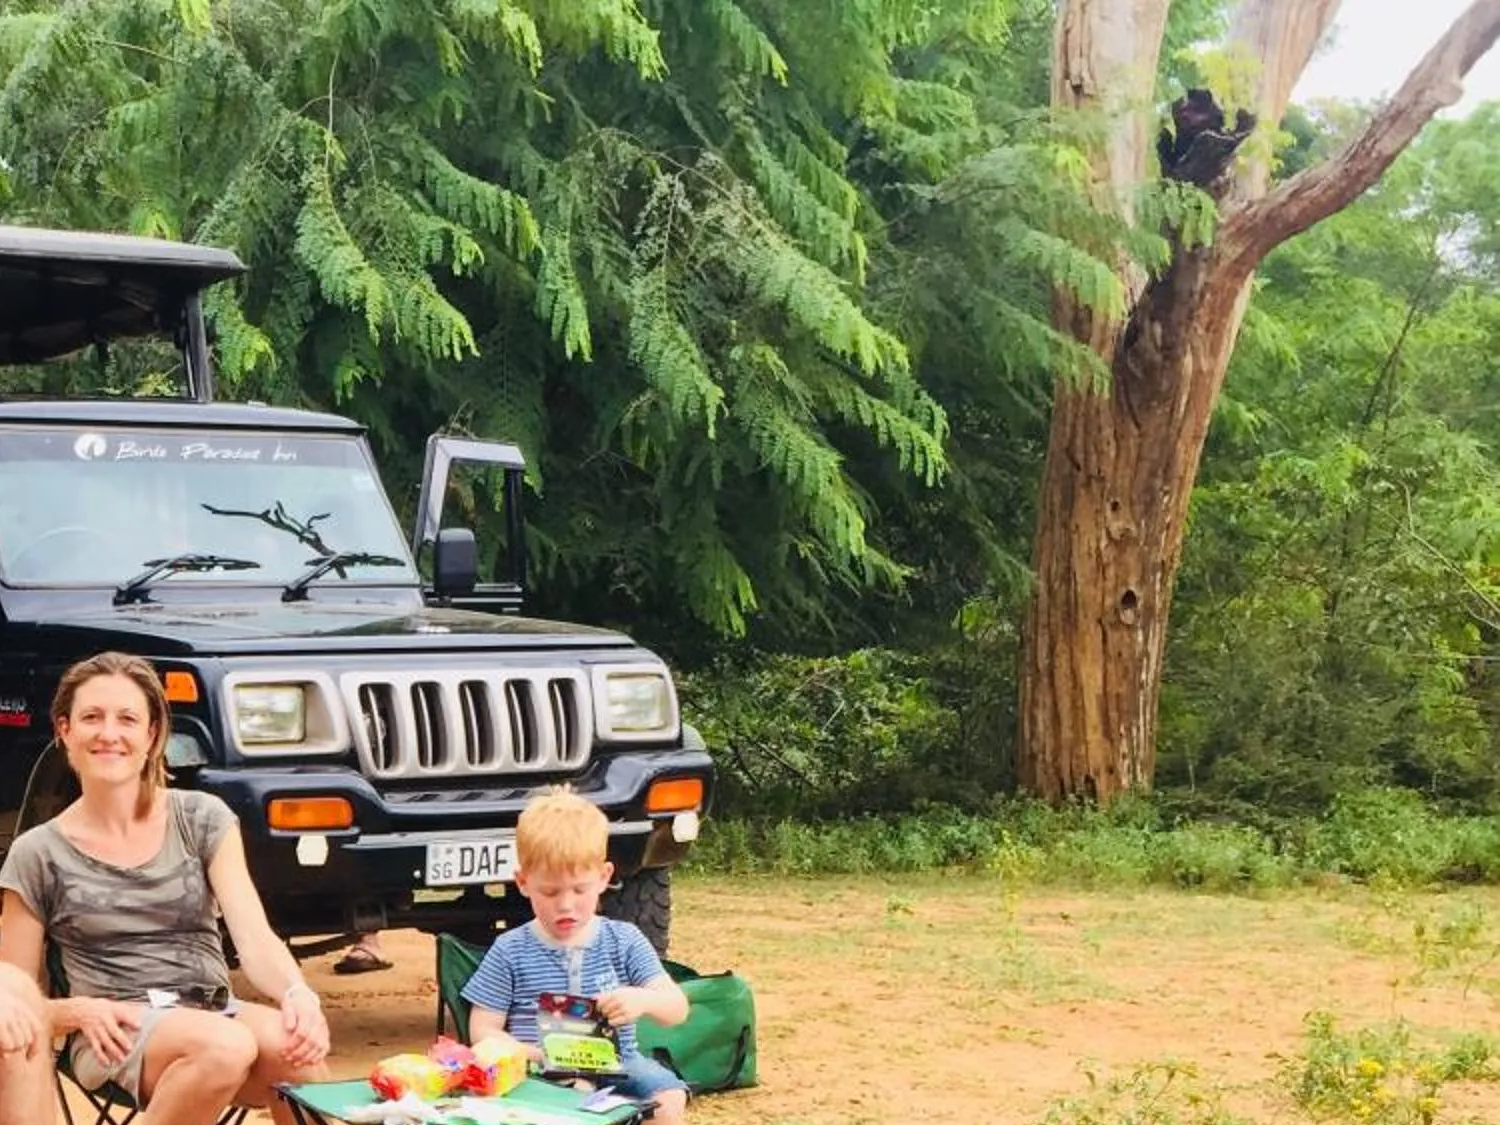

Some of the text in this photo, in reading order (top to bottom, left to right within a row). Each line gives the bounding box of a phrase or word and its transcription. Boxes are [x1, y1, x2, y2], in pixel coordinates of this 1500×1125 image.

[272, 440, 298, 461] Inn
[431, 861, 453, 879] SG
[459, 844, 511, 877] DAF
